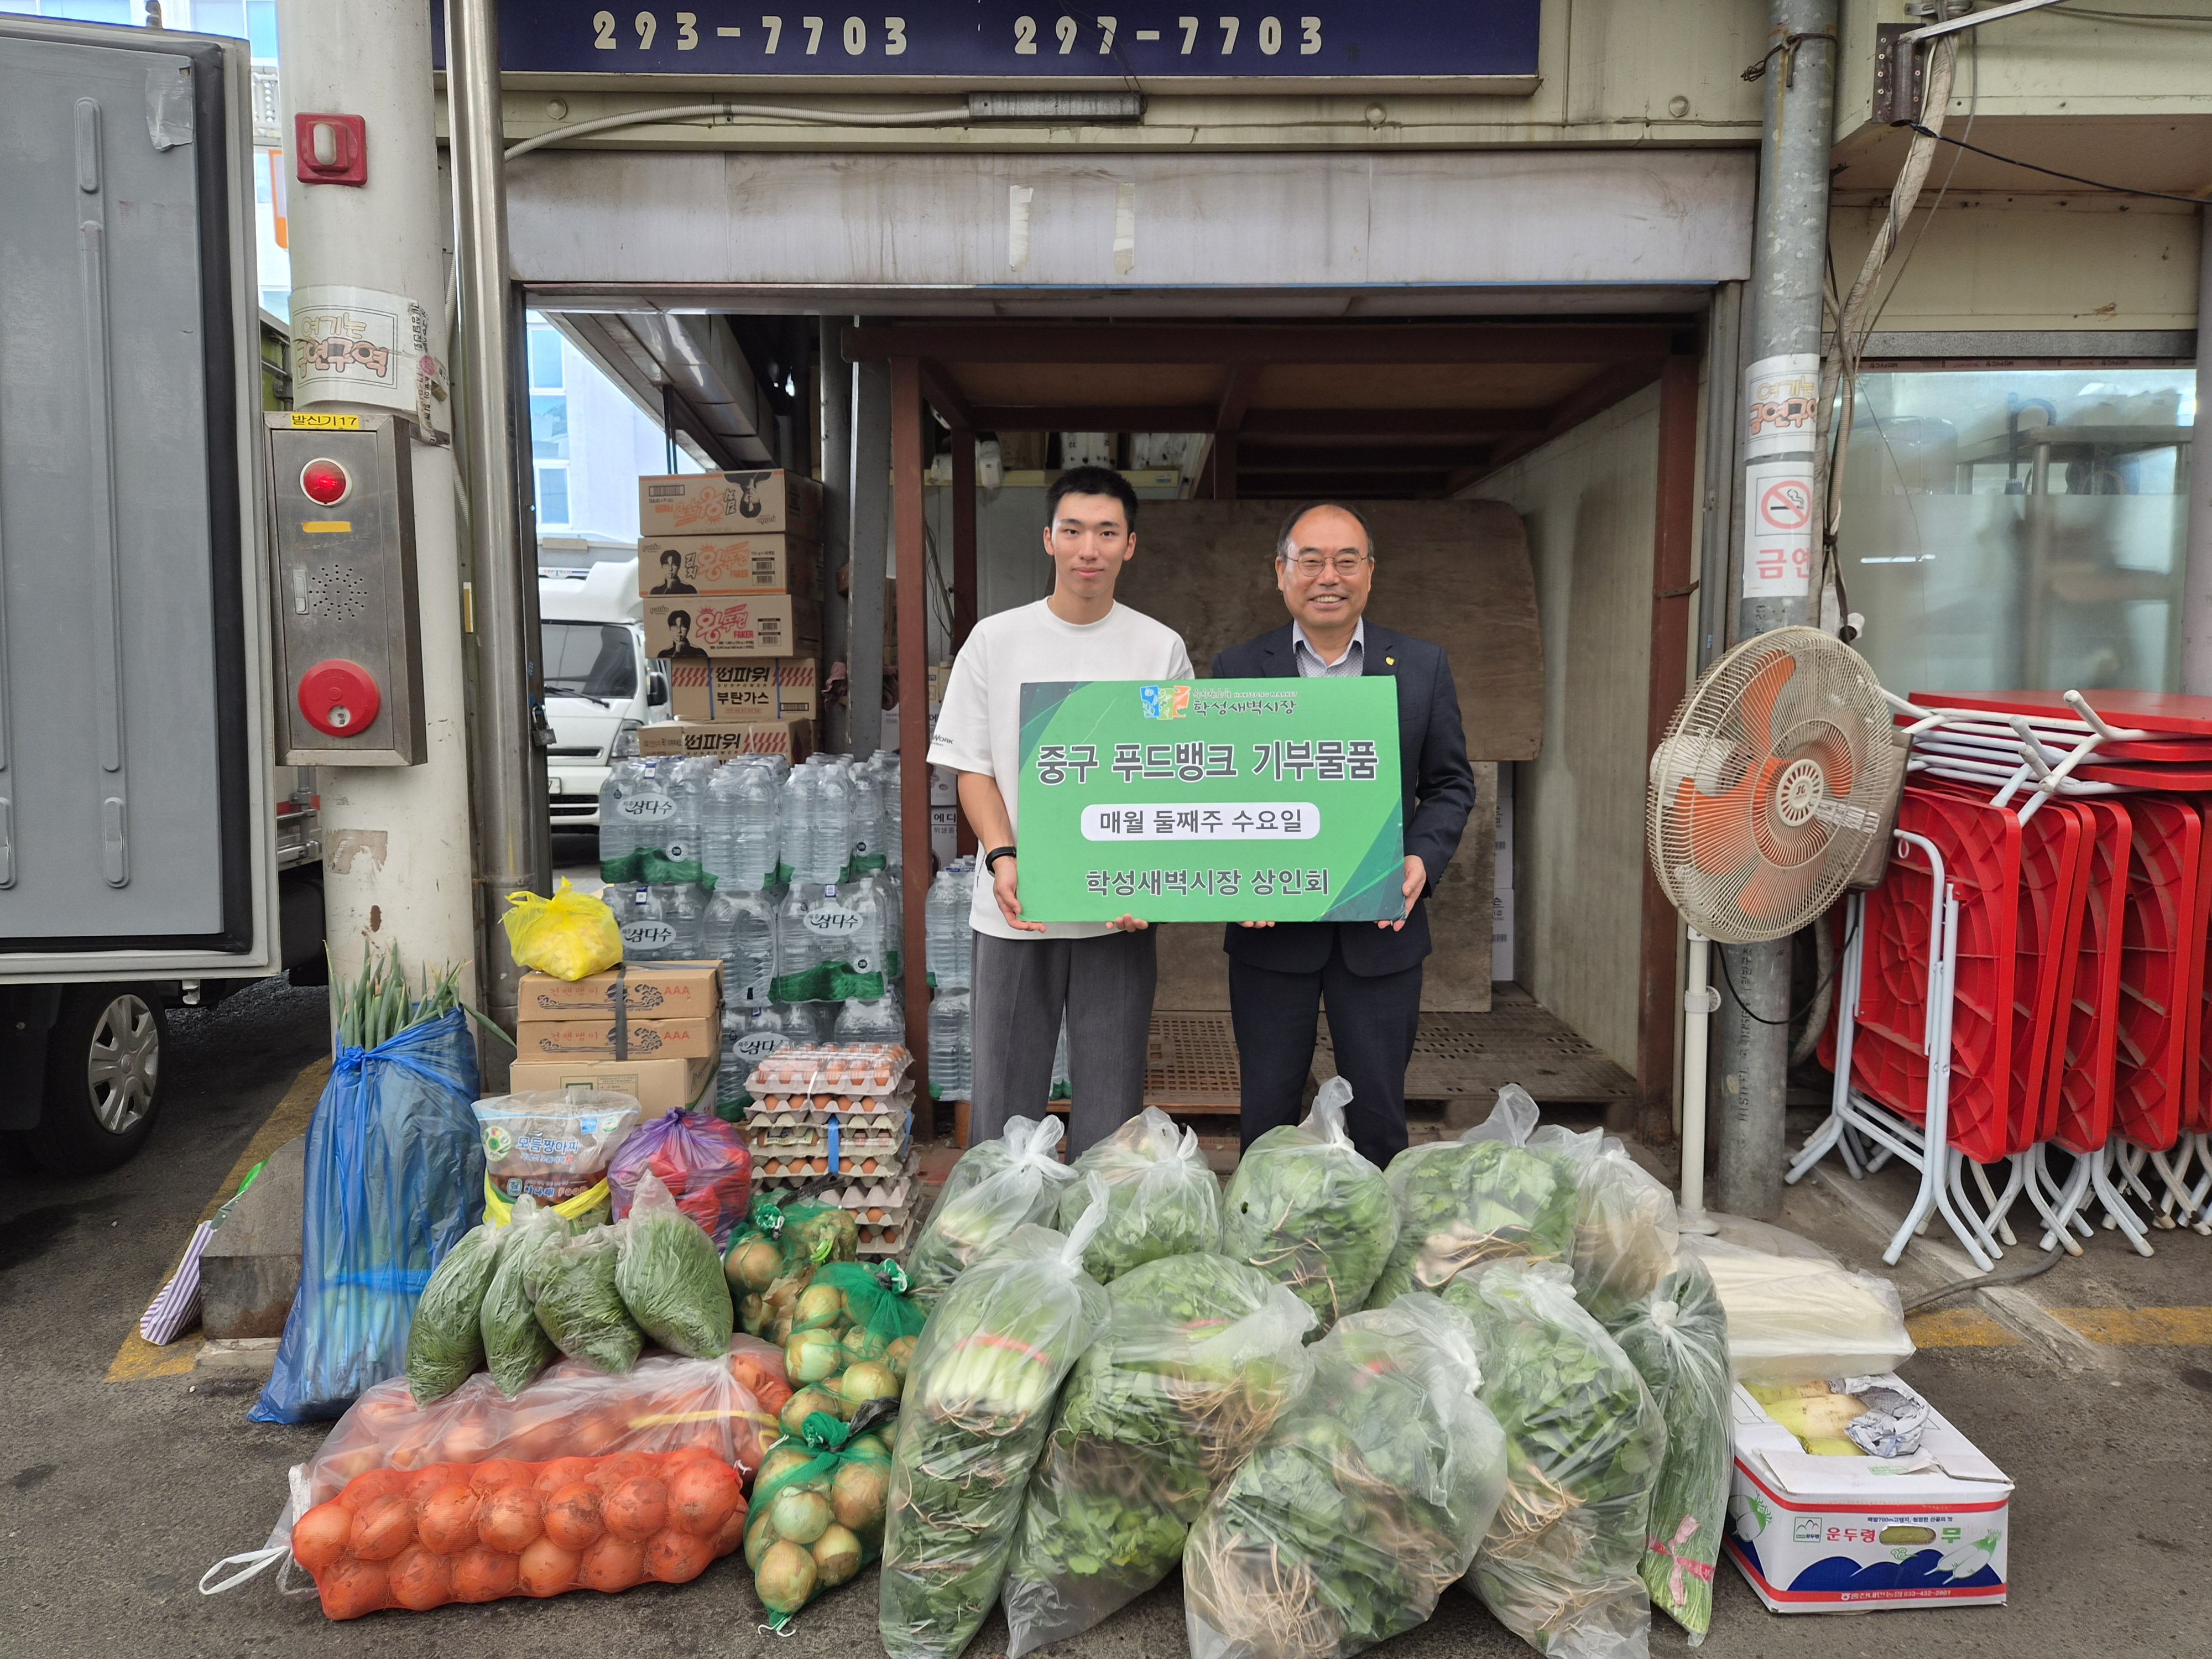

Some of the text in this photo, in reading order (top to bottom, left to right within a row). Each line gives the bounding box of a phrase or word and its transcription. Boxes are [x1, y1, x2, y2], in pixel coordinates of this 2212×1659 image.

[593, 11, 907, 55] 293-7703
[1014, 9, 1322, 54] 297-7703
[302, 312, 366, 339] 여기는
[1757, 375, 1814, 400] 여기는
[292, 415, 357, 426] 발신기17
[696, 611, 748, 644] 왕뚜껑
[734, 630, 754, 639] FAKER
[716, 667, 770, 682] 썬파워
[717, 692, 769, 705] 부탄가스
[1193, 700, 1298, 717] 학성새벽시장
[684, 733, 741, 750] 썬파워
[1036, 740, 1379, 786] 중구 푸드뱅크 기부물품
[625, 801, 673, 815] 삼다수
[1099, 809, 1302, 834] 매월 둘째주 수요일
[1086, 869, 1329, 896] 학성새벽시장 상인회
[811, 914, 859, 929] 삼다수
[625, 928, 672, 943] 삼다수
[664, 986, 690, 995] AAA
[664, 1031, 690, 1040] AAA
[516, 1137, 579, 1154] 모듬짱아찌
[1826, 1527, 1876, 1543] 운두령
[1941, 1527, 1961, 1543] 무
